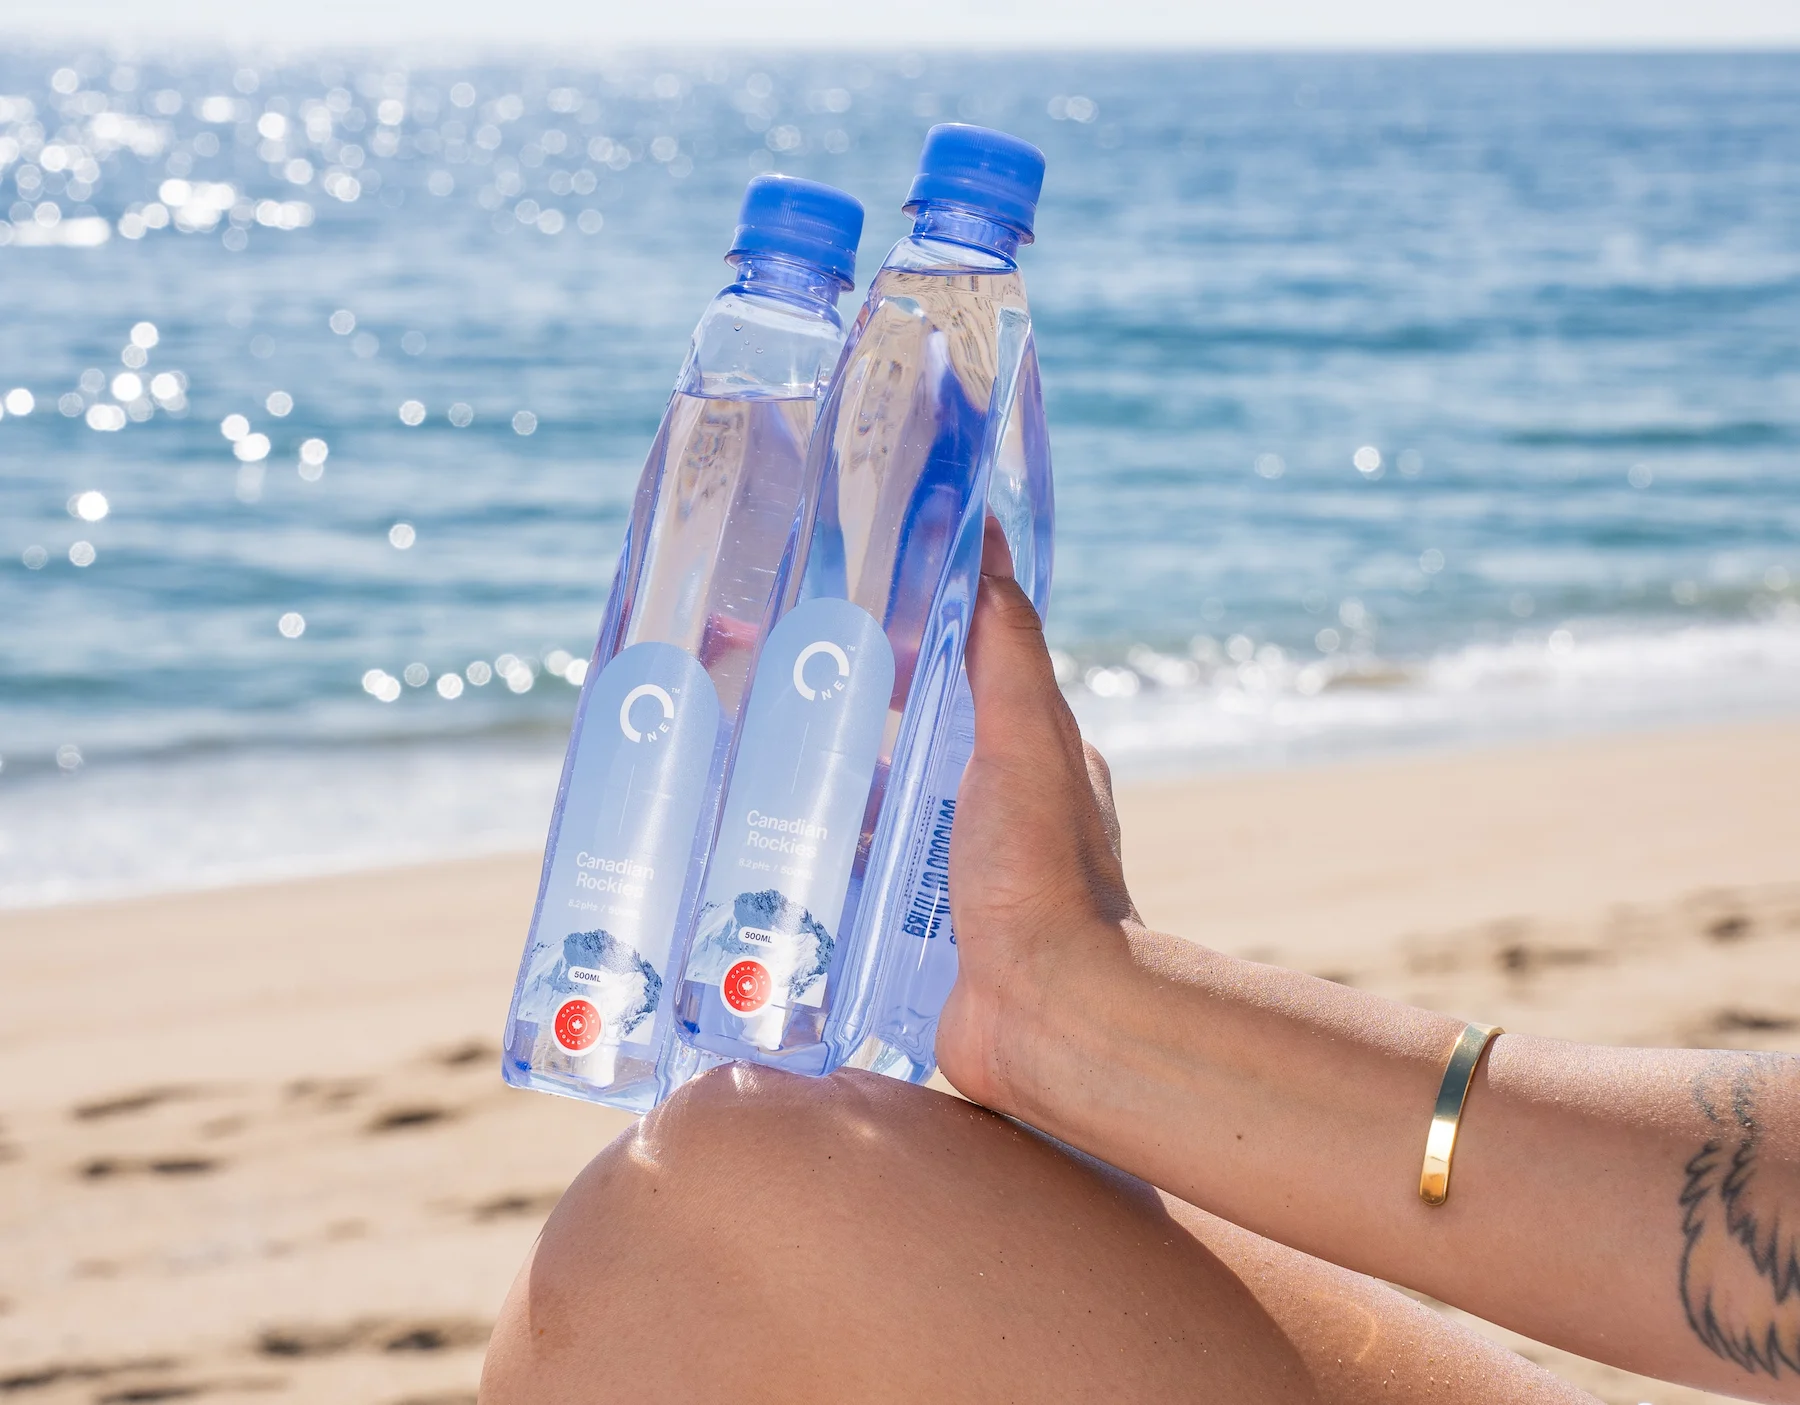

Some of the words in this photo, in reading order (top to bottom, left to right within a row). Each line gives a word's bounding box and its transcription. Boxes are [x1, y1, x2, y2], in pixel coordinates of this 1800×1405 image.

[746, 809, 828, 840] Canadian
[746, 830, 818, 859] Rockies
[576, 851, 655, 881] Canadian
[575, 871, 645, 899] Rockies
[744, 931, 773, 944] 500ML
[573, 970, 602, 983] 500ML
[731, 966, 766, 985] CANADIAN
[561, 1005, 596, 1024] CANADIAN
